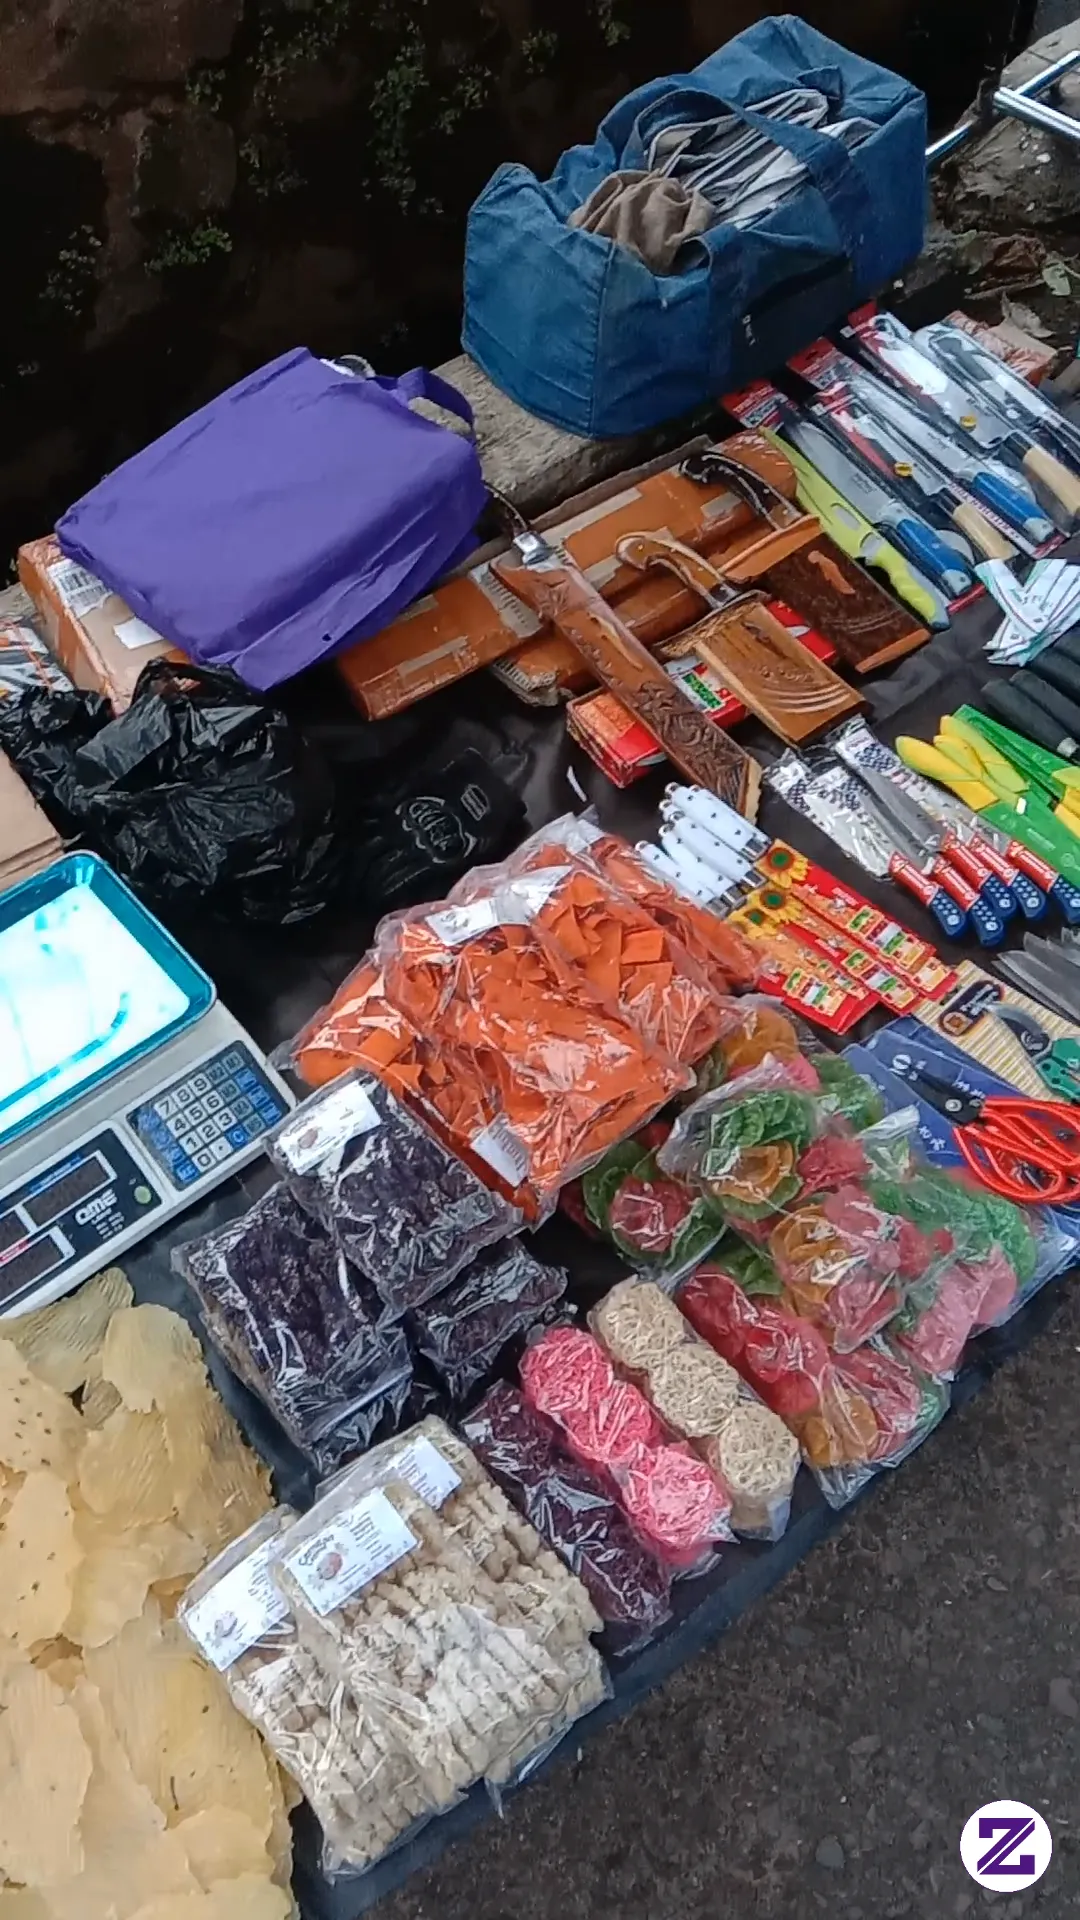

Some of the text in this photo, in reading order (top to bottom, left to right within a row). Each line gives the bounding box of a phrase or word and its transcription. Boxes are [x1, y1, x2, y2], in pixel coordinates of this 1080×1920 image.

[159, 1100, 173, 1116] 7
[177, 1088, 190, 1103] 8
[194, 1078, 207, 1092] 9
[174, 1118, 187, 1132] 4
[189, 1106, 203, 1121] 5
[206, 1095, 219, 1109] 6
[202, 1125, 216, 1139] 2
[219, 1112, 232, 1127] 3
[197, 1153, 210, 1167] 0
